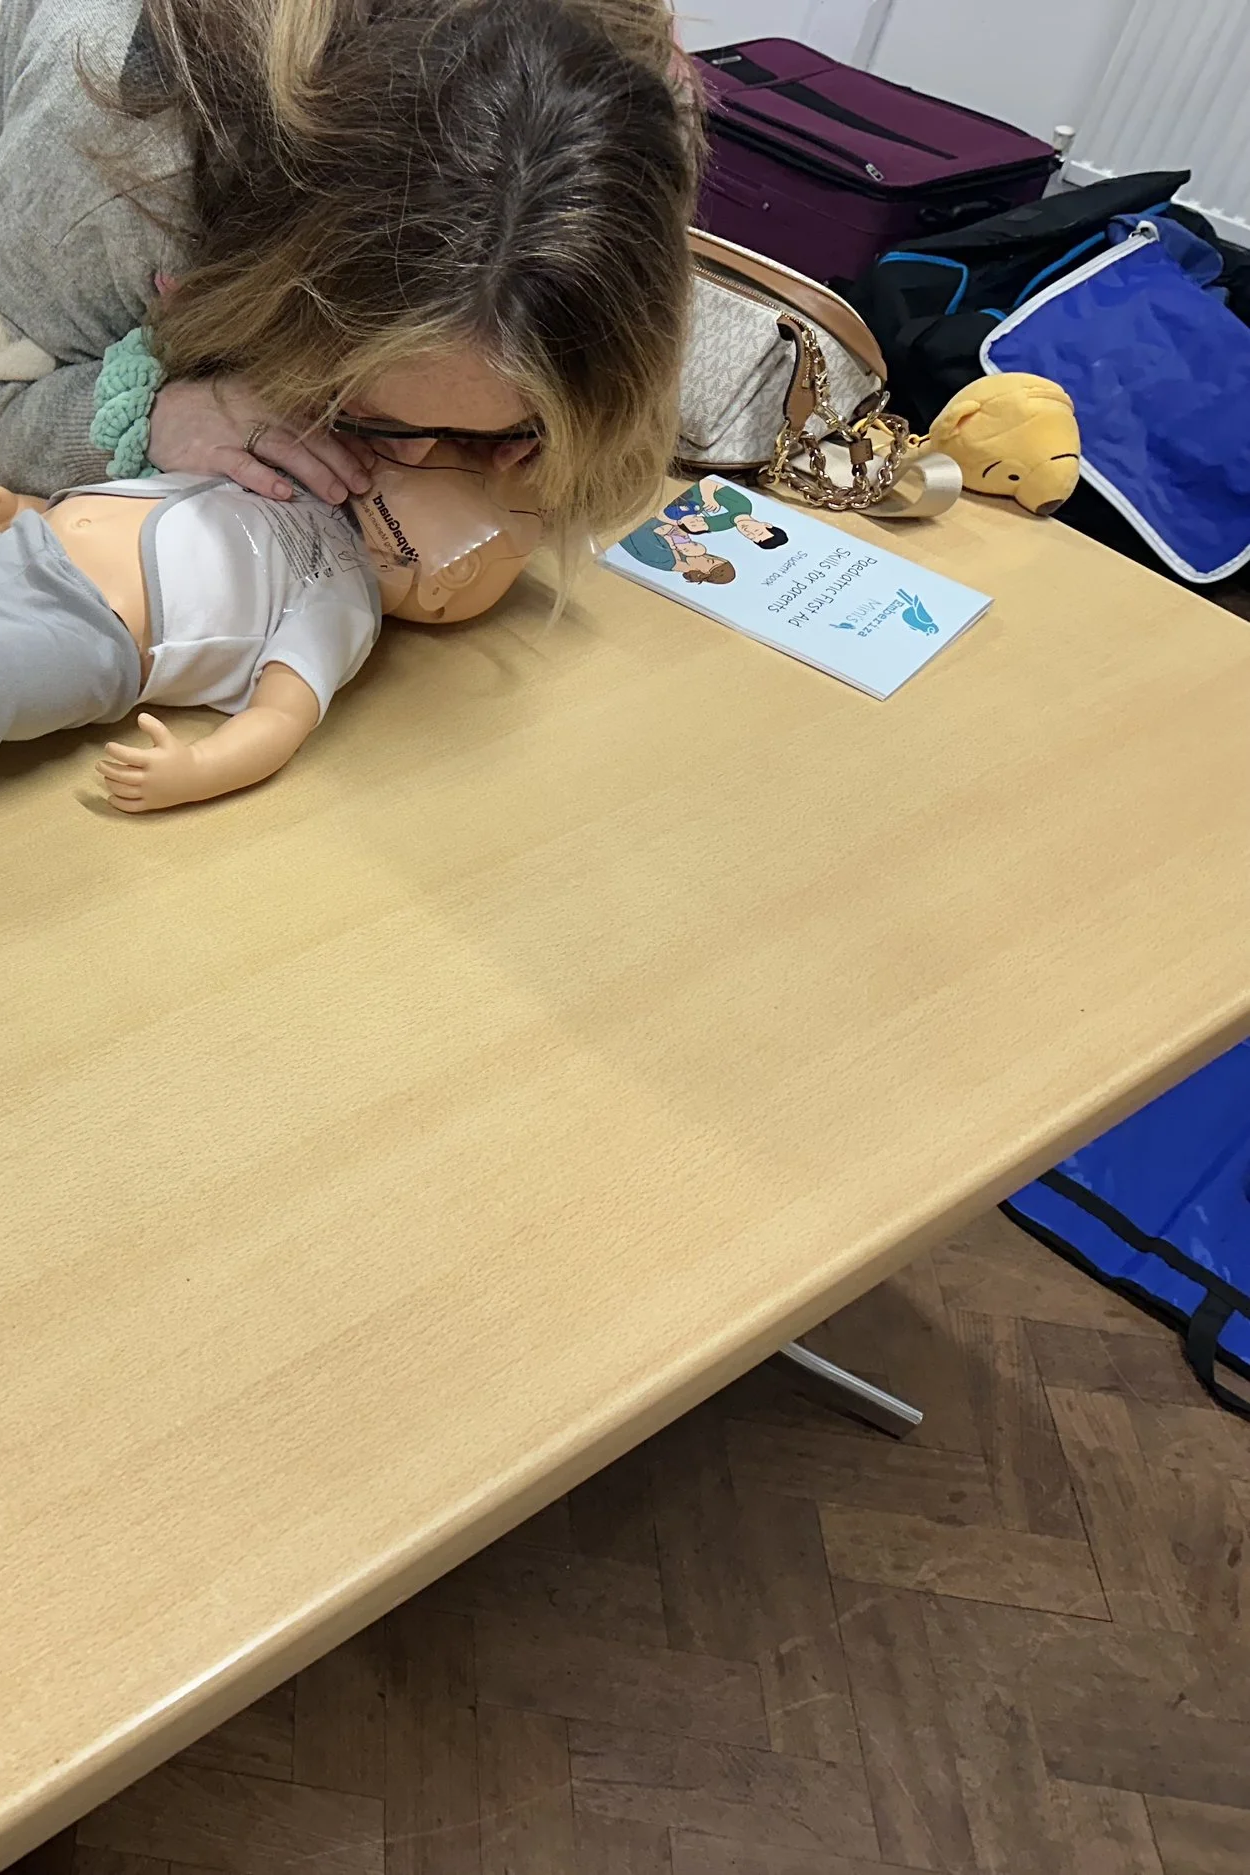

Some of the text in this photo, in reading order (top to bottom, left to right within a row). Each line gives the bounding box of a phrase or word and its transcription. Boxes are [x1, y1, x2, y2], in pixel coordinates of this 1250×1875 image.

[761, 550, 809, 587] Student book
[767, 547, 852, 614] Skills for parents
[788, 555, 879, 629] Paediatric First Aid
[857, 599, 906, 638] Emberiza
